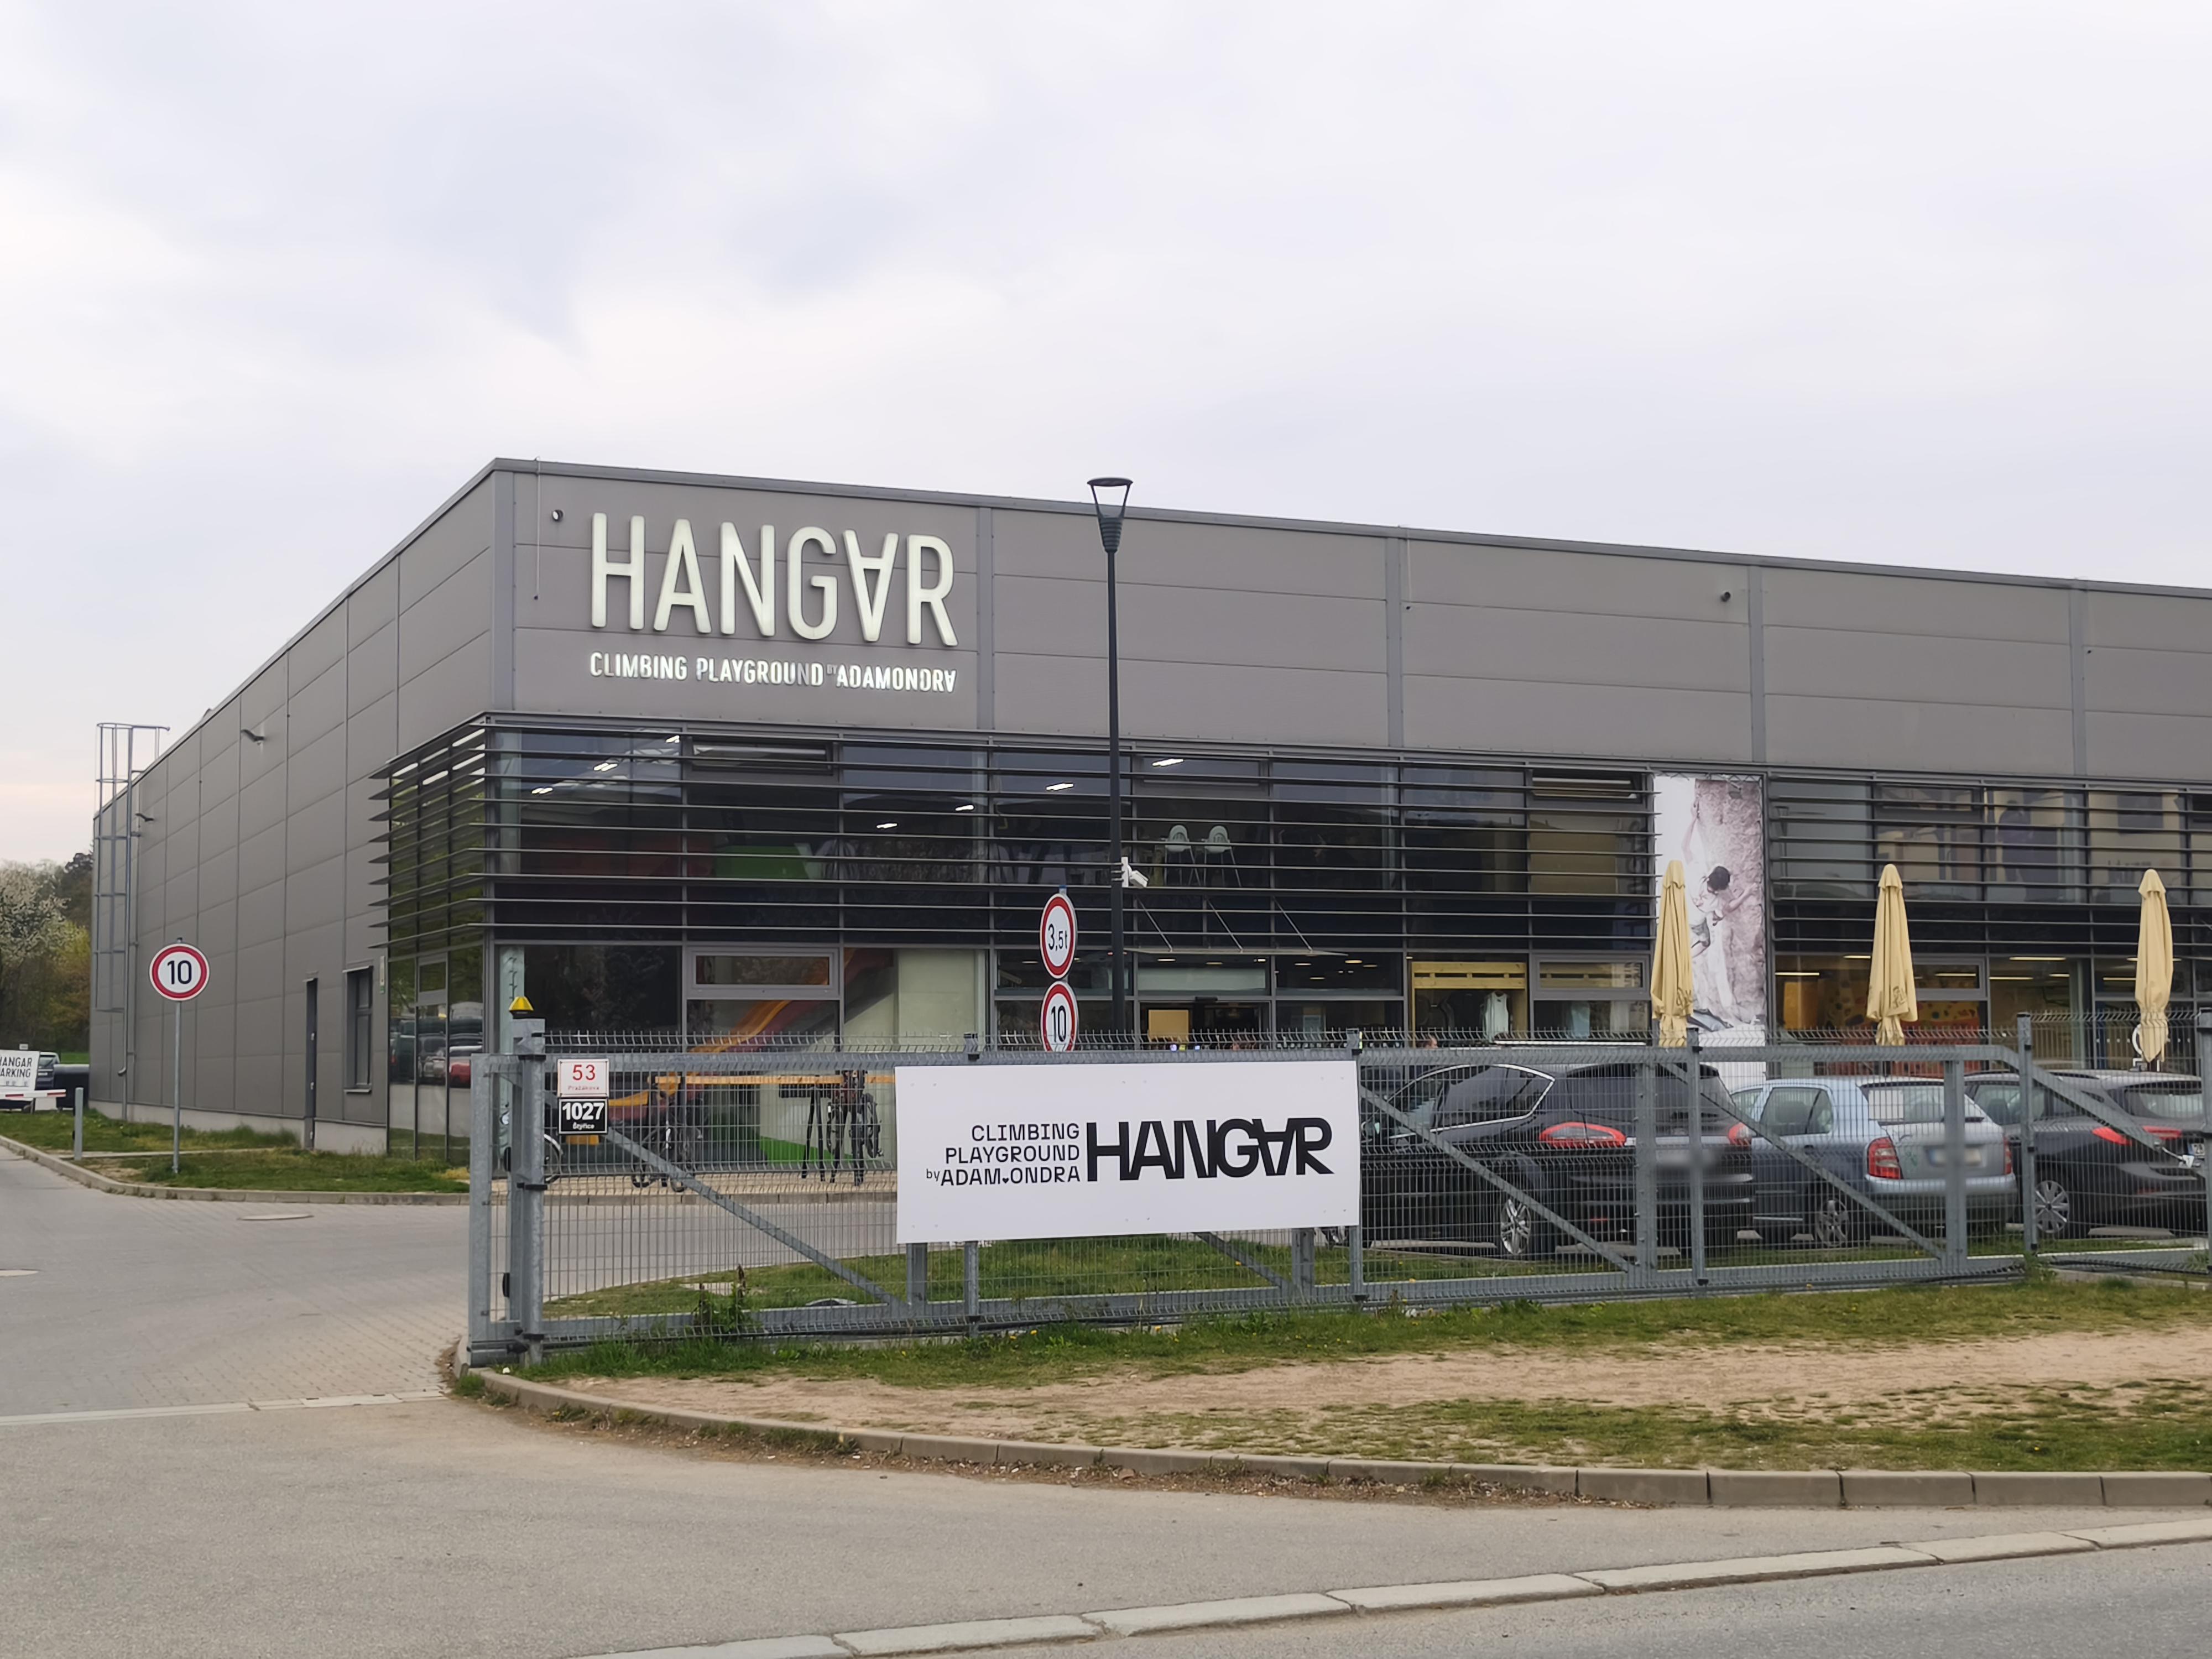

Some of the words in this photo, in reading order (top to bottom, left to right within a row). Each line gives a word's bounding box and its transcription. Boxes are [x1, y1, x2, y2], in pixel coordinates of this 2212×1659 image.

[589, 651, 687, 681] CLIMBING
[696, 657, 823, 687] PLAYGROUND
[167, 960, 192, 984] 10
[1051, 1005, 1067, 1043] 10
[0, 1068, 31, 1078] ARKING
[572, 1064, 596, 1081] 53
[562, 1102, 604, 1120] 1027
[971, 1123, 1080, 1141] CLIMBING
[946, 1144, 1080, 1164] PLAYGROUND
